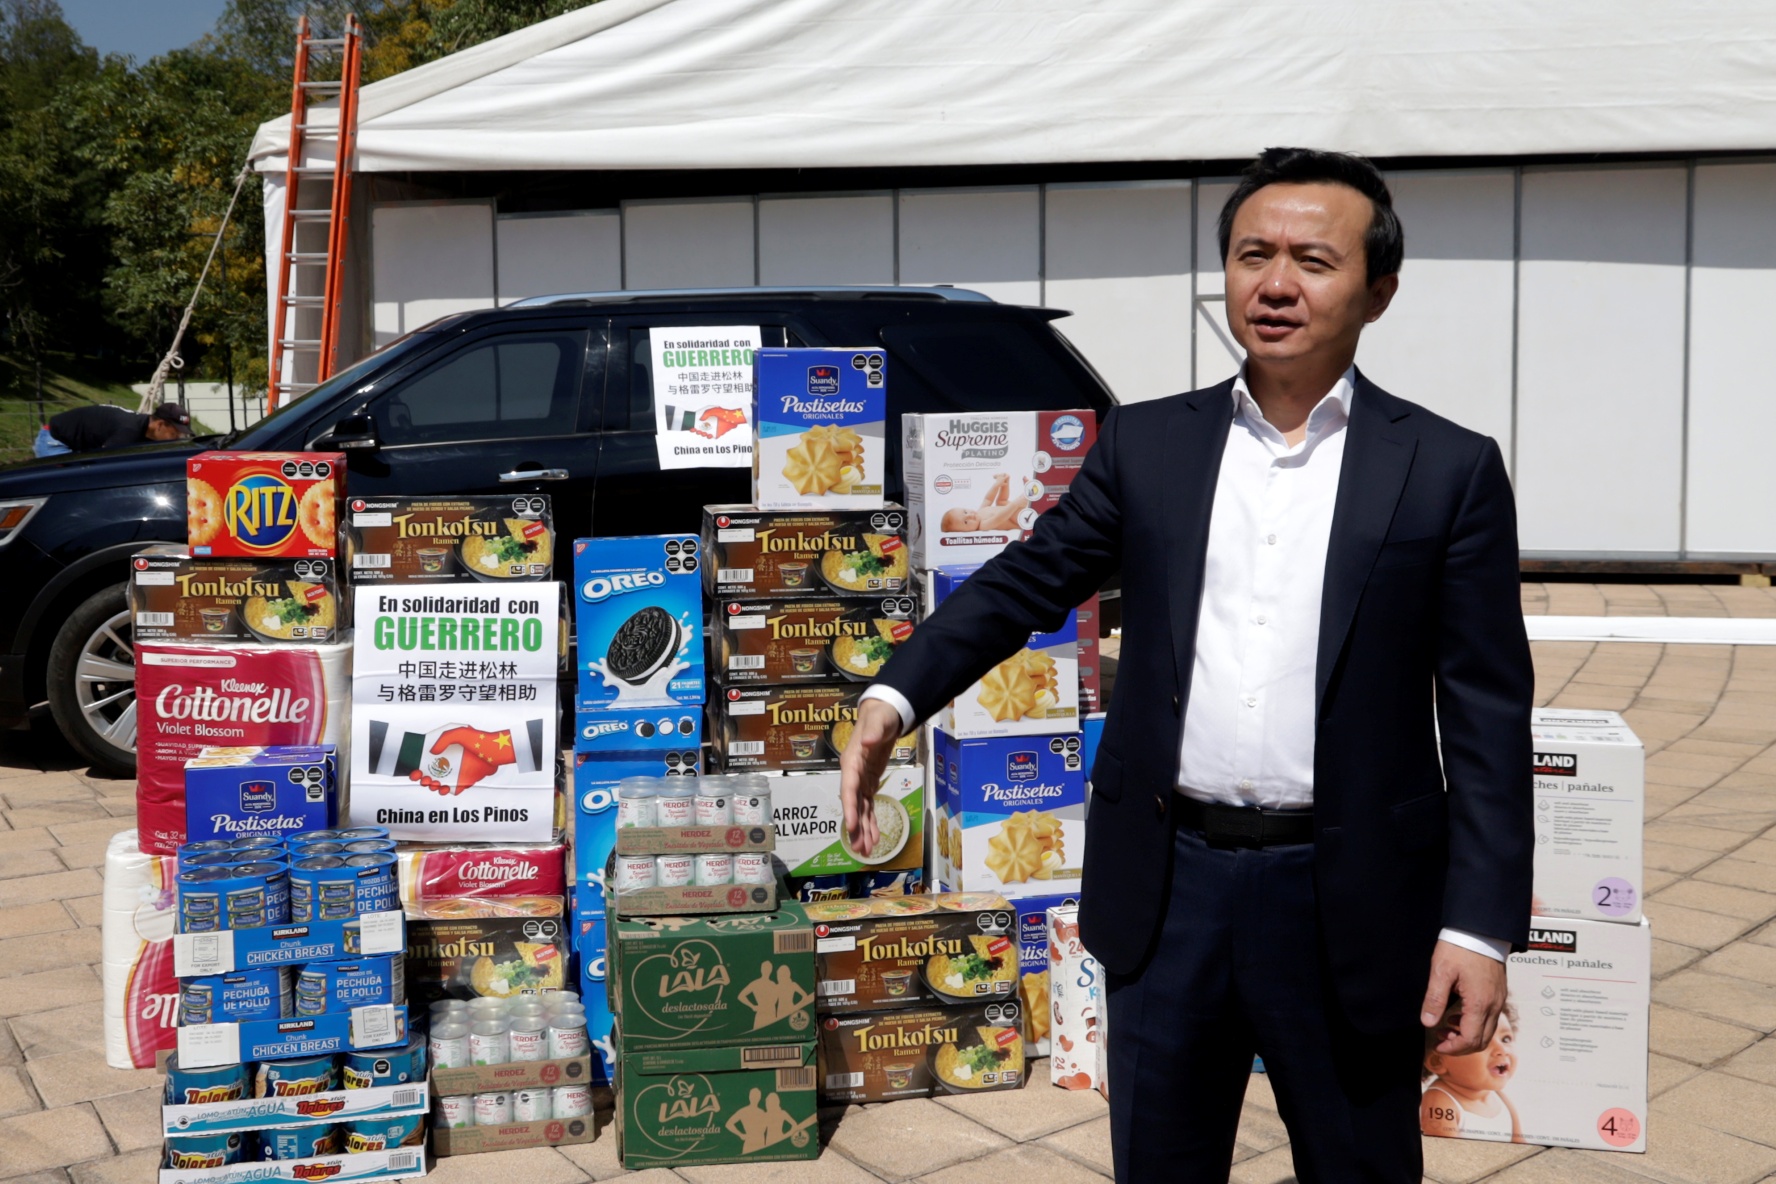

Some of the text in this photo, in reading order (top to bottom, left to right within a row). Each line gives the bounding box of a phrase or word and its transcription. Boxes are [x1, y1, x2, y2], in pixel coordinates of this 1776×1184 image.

[664, 339, 751, 349] En solidaridad con
[662, 348, 753, 368] GUERRERO
[678, 371, 743, 382] 中国走进松林
[810, 376, 838, 386] Suandy
[668, 383, 753, 396] 与格雷罗守望相助
[781, 396, 864, 414] Pastisetas
[950, 419, 1008, 434] HUGGIES
[935, 430, 1008, 451] Supreme
[674, 444, 752, 456] China en Los Pino
[229, 485, 293, 537] RITZ
[393, 513, 497, 539] Tonkotsu
[756, 528, 856, 554] Tonkotsu
[176, 573, 279, 598] Tonkotsu
[582, 571, 665, 598] OREO
[379, 596, 539, 614] En solidaridad con
[374, 616, 542, 652] GUERRERO
[767, 615, 866, 640] Tonkotsu
[398, 661, 518, 680] 中国走进松林
[221, 678, 266, 696] Kleenex
[671, 680, 680, 689] 21
[377, 684, 537, 702] 与格雷罗守望相助
[155, 684, 310, 724] Cottonelle
[156, 722, 244, 738] Violet Blossom
[583, 721, 628, 738] OREO
[1009, 761, 1036, 772] Suandy
[1534, 755, 1574, 767] LAND
[981, 783, 1063, 802] Pastisetas
[1533, 781, 1614, 792] ches pañales
[243, 792, 273, 802] Suandy
[1003, 798, 1043, 807] ORIGINALES
[376, 806, 529, 824] China en Los Pinos
[774, 806, 817, 821] ARROZ
[210, 814, 304, 833] Pastisetas
[774, 820, 836, 836] AL VAPOR
[170, 831, 178, 839] 32
[236, 830, 282, 838] ORIGINALES
[681, 830, 711, 838] HERDEZ
[813, 855, 820, 864] 6
[458, 862, 538, 880] Cottonelle
[360, 877, 380, 885] TROZOS
[1598, 886, 1611, 906] 2
[358, 901, 372, 911] DE
[273, 927, 308, 937] KIRKLAND
[829, 925, 860, 933] NONGSHIM
[1022, 923, 1047, 932] Suandy
[280, 940, 301, 949] Chunk
[1529, 931, 1574, 944] KLAND
[247, 945, 334, 963] CHICKEN BREAST
[406, 937, 495, 958] onkotsu
[857, 935, 962, 963] Tonkotsu
[1068, 941, 1084, 954] 24
[897, 959, 924, 967] Ramen
[1510, 955, 1613, 970] couches pañales
[337, 976, 382, 988] PECHUGA
[659, 964, 730, 998] LALA
[224, 986, 270, 999] PECHUGA
[337, 986, 382, 998] DE POLLO
[224, 998, 270, 1010] DE POLLO
[662, 1000, 727, 1014] deslactosada
[279, 1021, 314, 1030] KIRKLAND
[839, 1018, 868, 1027] NONGSHIM
[286, 1033, 307, 1042] Chunk
[853, 1025, 958, 1053] Tonkotsu
[252, 1038, 340, 1056] CHICKEN BREAST
[894, 1048, 920, 1056] Ramen
[494, 1069, 525, 1077] HERDEZ
[547, 1066, 554, 1074] 12
[186, 1087, 242, 1103] Dolores
[275, 1079, 329, 1097] Dolores
[198, 1102, 286, 1120] LOMO ATÚN AGUA
[297, 1100, 345, 1115] Dolores
[659, 1094, 720, 1123] LALA
[1428, 1107, 1455, 1121] 198
[498, 1126, 530, 1135] HERDEZ
[551, 1124, 559, 1132] 12
[658, 1125, 720, 1136] deslactosada
[1602, 1116, 1618, 1136] 4
[172, 1151, 224, 1168] Dolores
[244, 1166, 281, 1181] AGUA
[293, 1165, 341, 1178] Dolores
